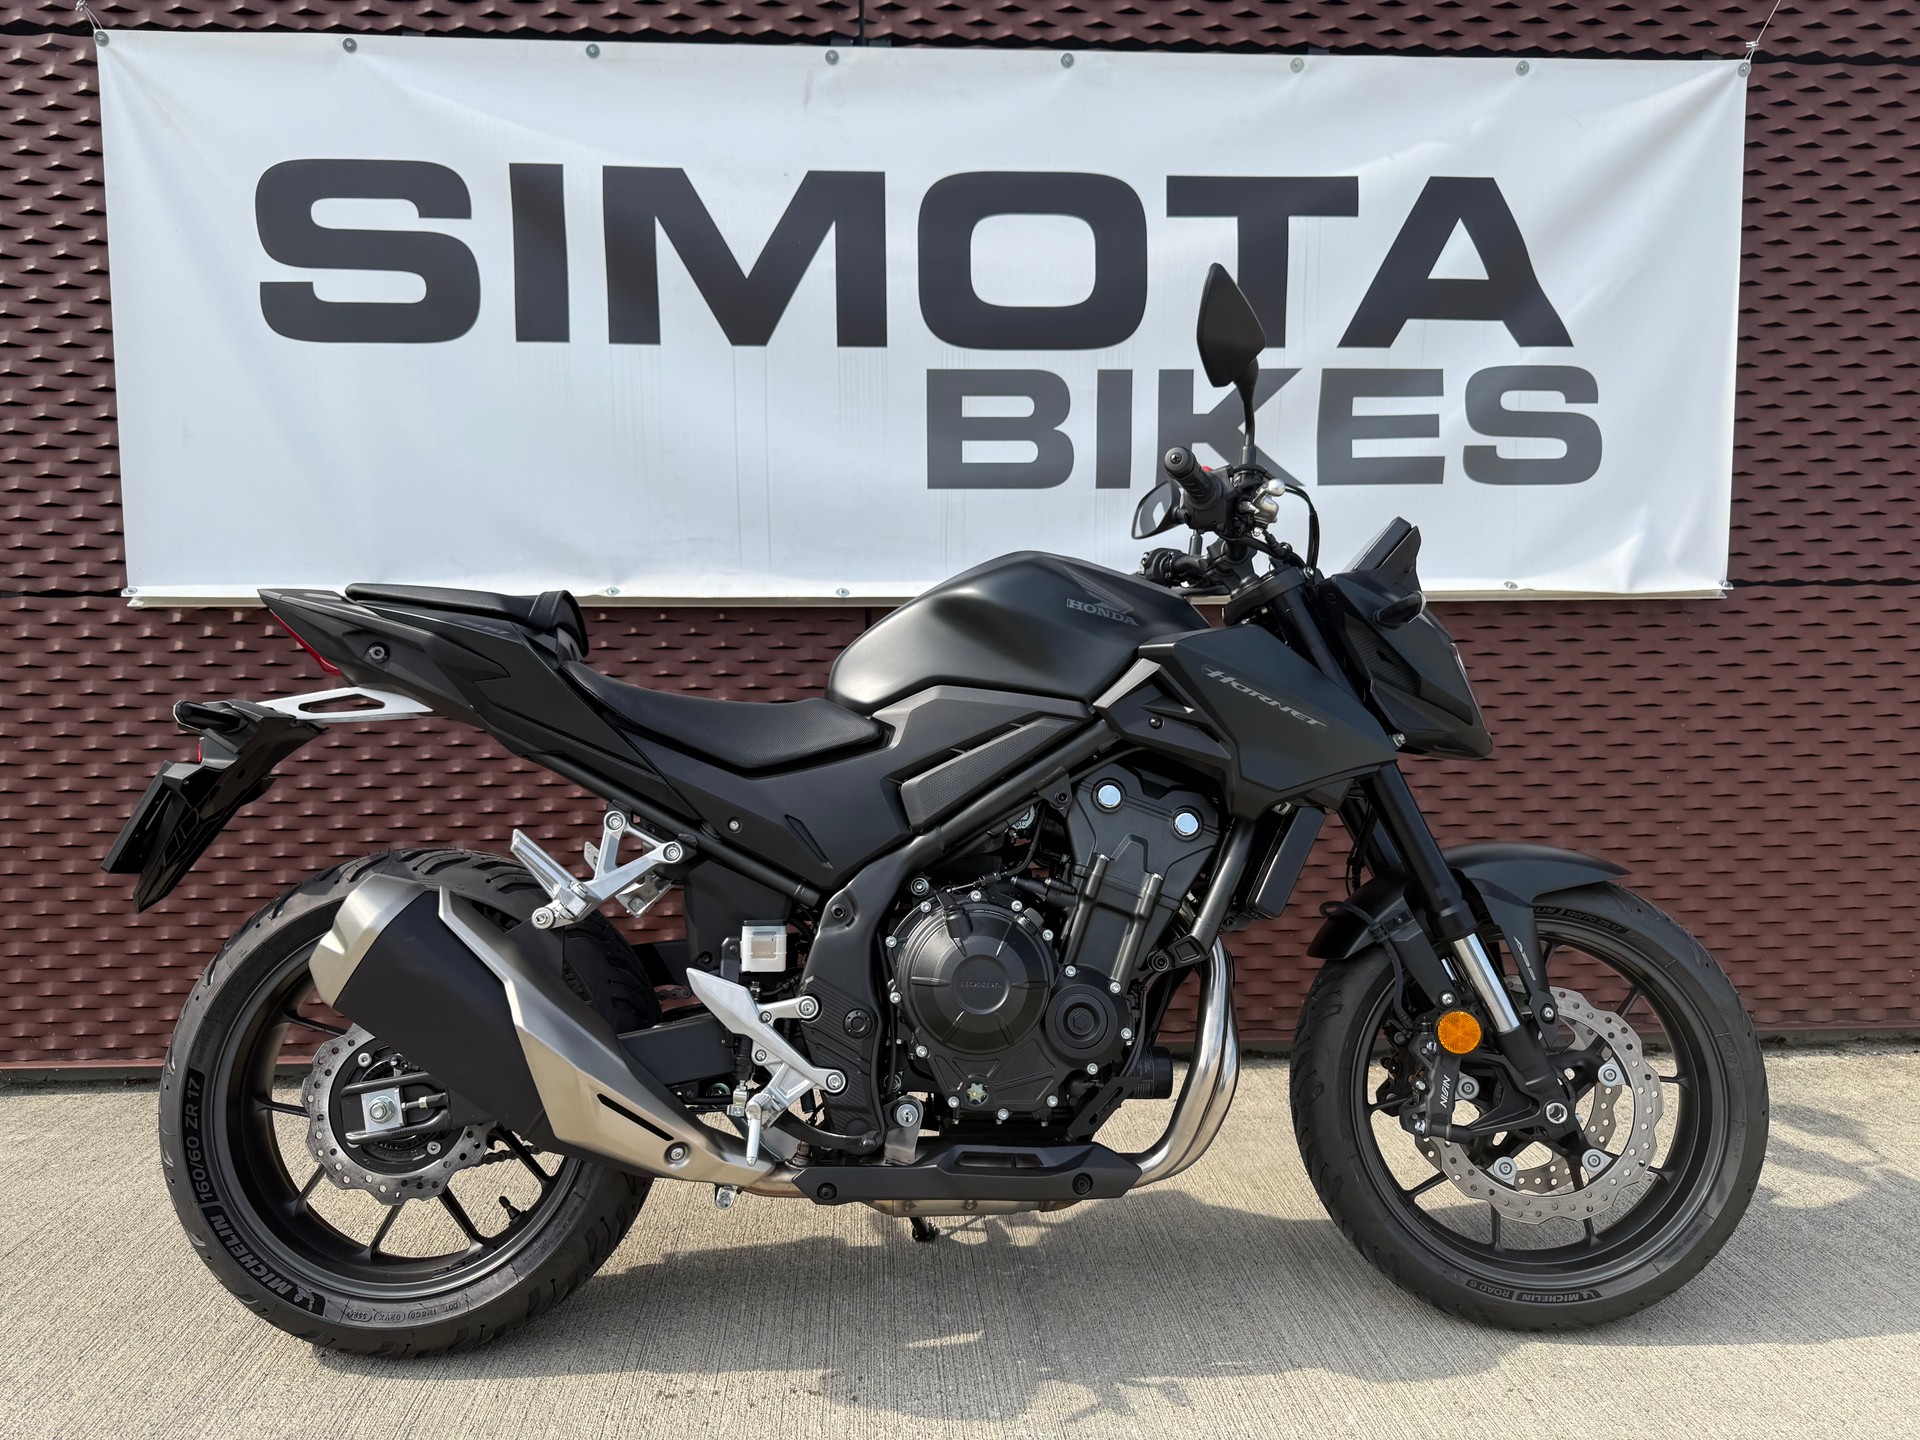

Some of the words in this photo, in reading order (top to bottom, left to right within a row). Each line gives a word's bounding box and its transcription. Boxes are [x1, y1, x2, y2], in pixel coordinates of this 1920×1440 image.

[255, 158, 1574, 350] SIMOTA
[927, 364, 1602, 489] BIKES
[1066, 598, 1140, 626] HONDA
[1203, 667, 1327, 727] HORNET
[960, 980, 1004, 989] HONDA
[187, 1076, 201, 1097] 17
[1440, 1074, 1451, 1109] NISSIN
[185, 1102, 200, 1131] ZR
[185, 1136, 214, 1201] 160/60
[209, 1214, 295, 1296] MICHELIN
[1468, 1279, 1477, 1288] 6
[1479, 1284, 1511, 1299] ROAD
[1521, 1291, 1580, 1302] MICHELIN
